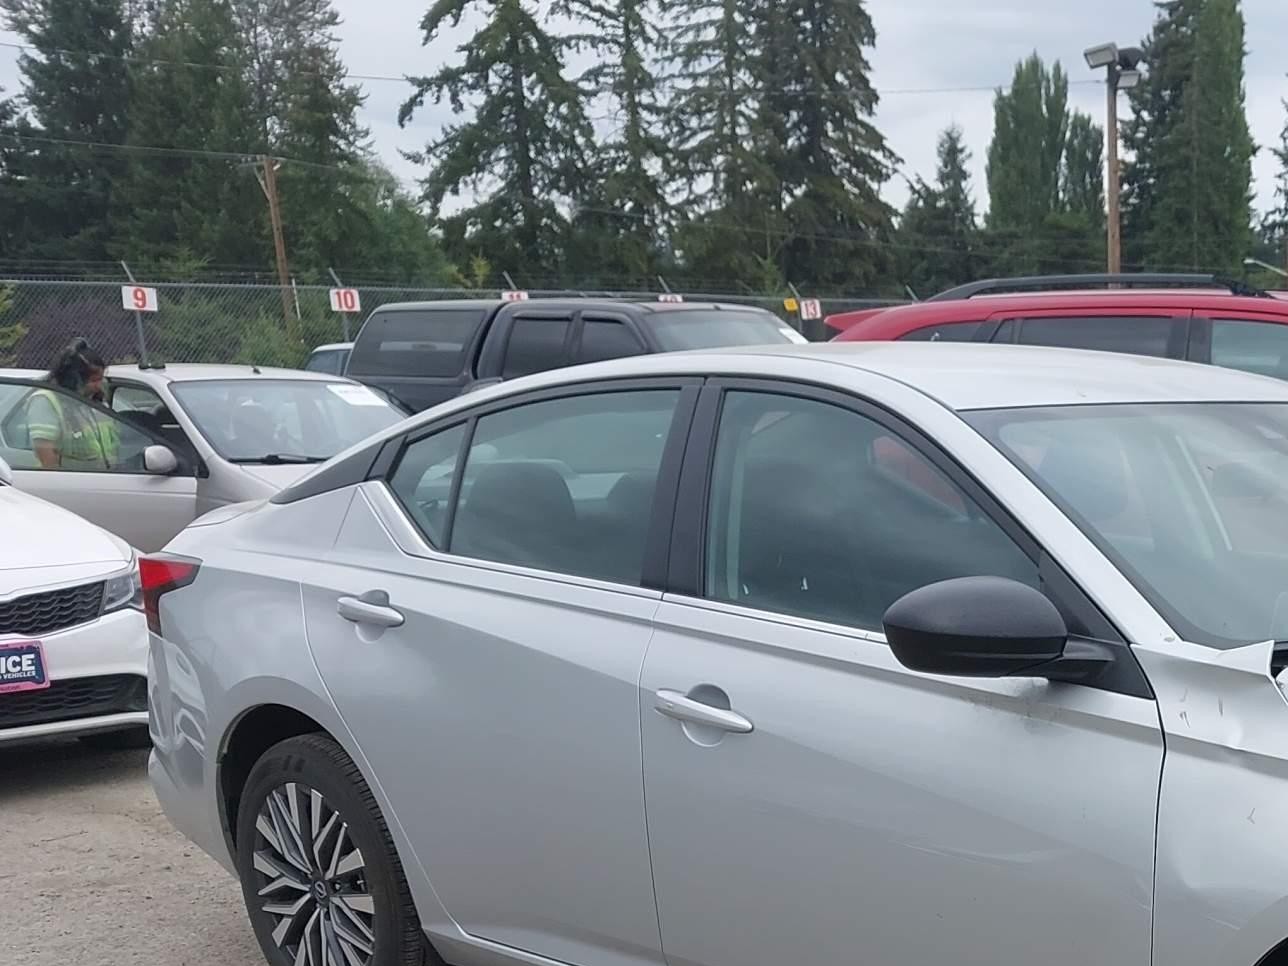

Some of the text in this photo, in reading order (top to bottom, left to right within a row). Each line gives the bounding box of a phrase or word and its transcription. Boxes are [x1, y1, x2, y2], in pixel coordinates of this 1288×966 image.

[133, 287, 147, 309] 9
[335, 290, 355, 310] 10
[3, 670, 36, 680] VEHICLES
